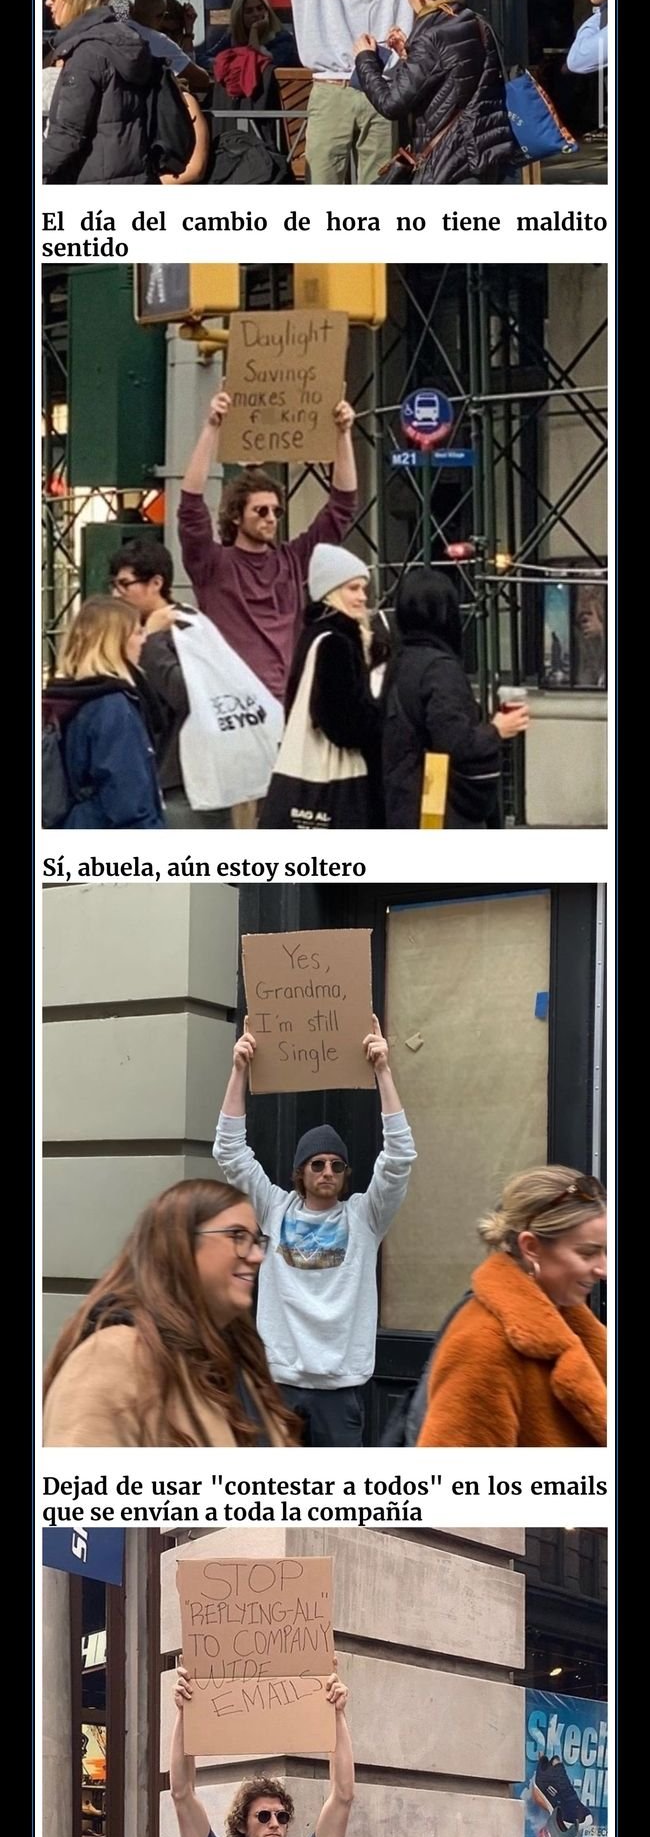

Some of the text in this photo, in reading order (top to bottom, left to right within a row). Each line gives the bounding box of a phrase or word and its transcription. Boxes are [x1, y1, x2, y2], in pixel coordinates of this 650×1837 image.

[240, 319, 334, 358] Daylight
[243, 358, 317, 389] Savings
[232, 390, 323, 408] makes no
[392, 452, 417, 466] M21
[282, 943, 331, 973] Yes,
[255, 979, 347, 1001] Grandma,
[255, 1009, 339, 1034] I'm still
[278, 1040, 339, 1074] Single
[200, 1559, 304, 1601] STOP
[188, 1621, 332, 1658] TO COMPANY
[194, 1659, 275, 1690] WIDE
[211, 1669, 323, 1717] EMAILS
